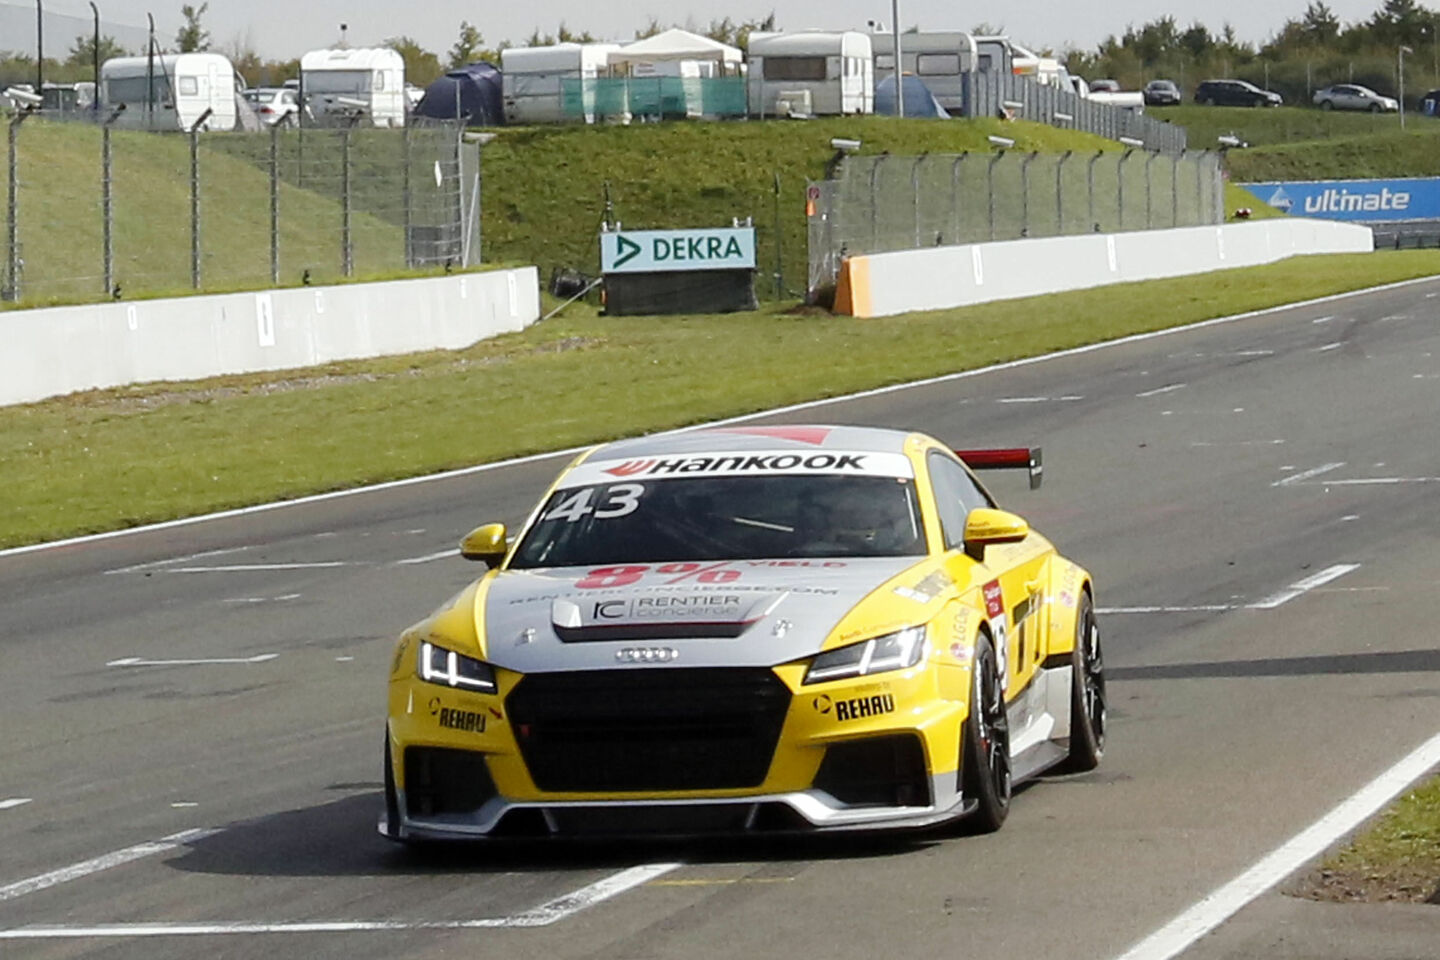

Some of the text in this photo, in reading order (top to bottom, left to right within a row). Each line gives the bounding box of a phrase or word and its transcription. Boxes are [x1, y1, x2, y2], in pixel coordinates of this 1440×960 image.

[1304, 187, 1410, 213] ultimate
[653, 235, 743, 262] DEKRA
[545, 483, 646, 523] 43
[574, 562, 742, 589] 8%
[637, 595, 740, 608] RENTIER
[637, 604, 738, 619] concierge
[439, 707, 487, 733] REHAU
[835, 693, 895, 721] REHAU
